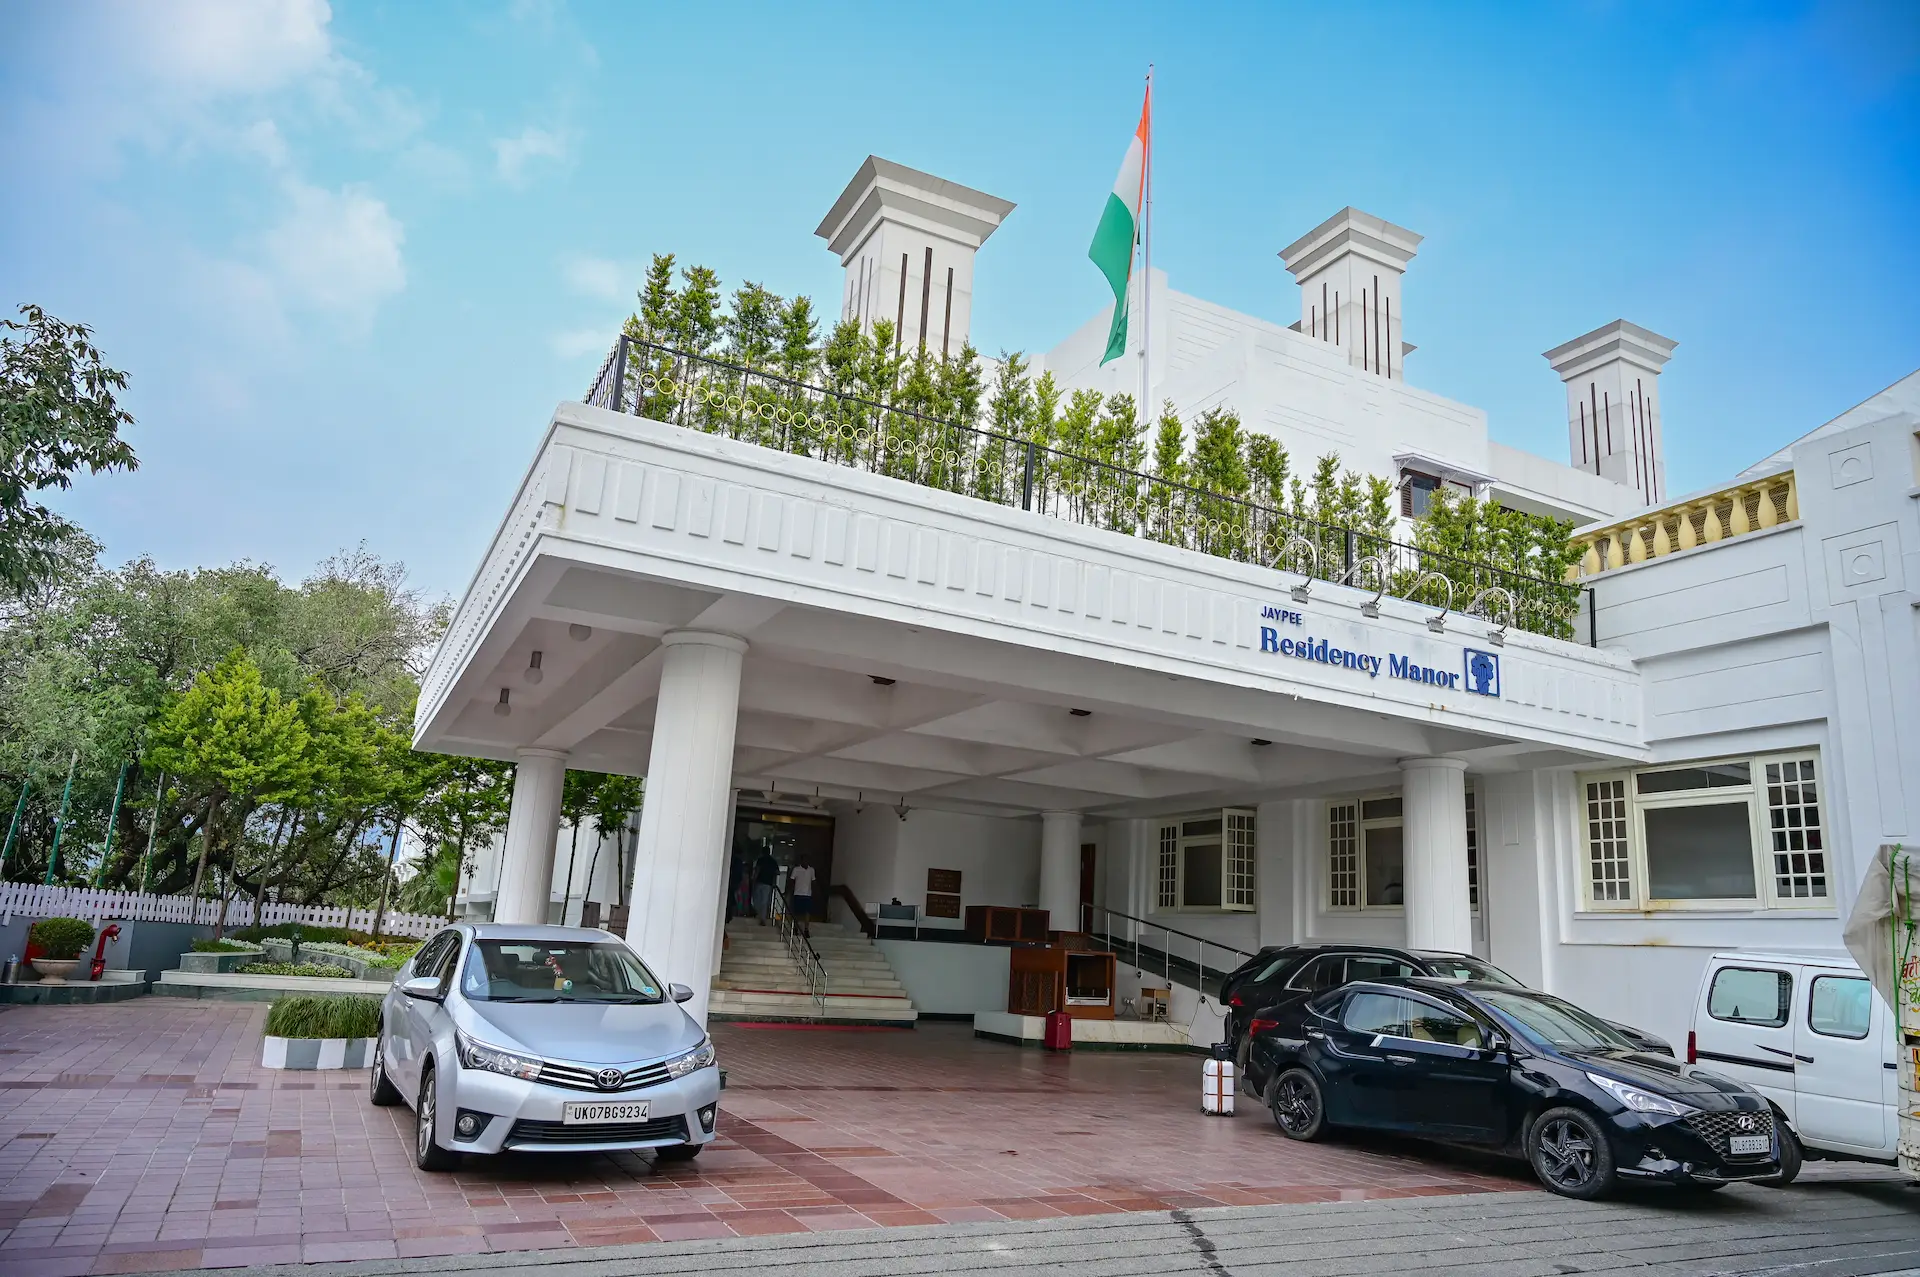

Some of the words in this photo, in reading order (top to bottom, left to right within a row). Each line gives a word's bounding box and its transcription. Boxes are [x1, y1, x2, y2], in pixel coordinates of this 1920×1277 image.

[1261, 605, 1303, 626] JAYPEE
[1260, 625, 1383, 678] Residency
[1389, 652, 1460, 689] Manor
[574, 1105, 647, 1120] UK07BG9234
